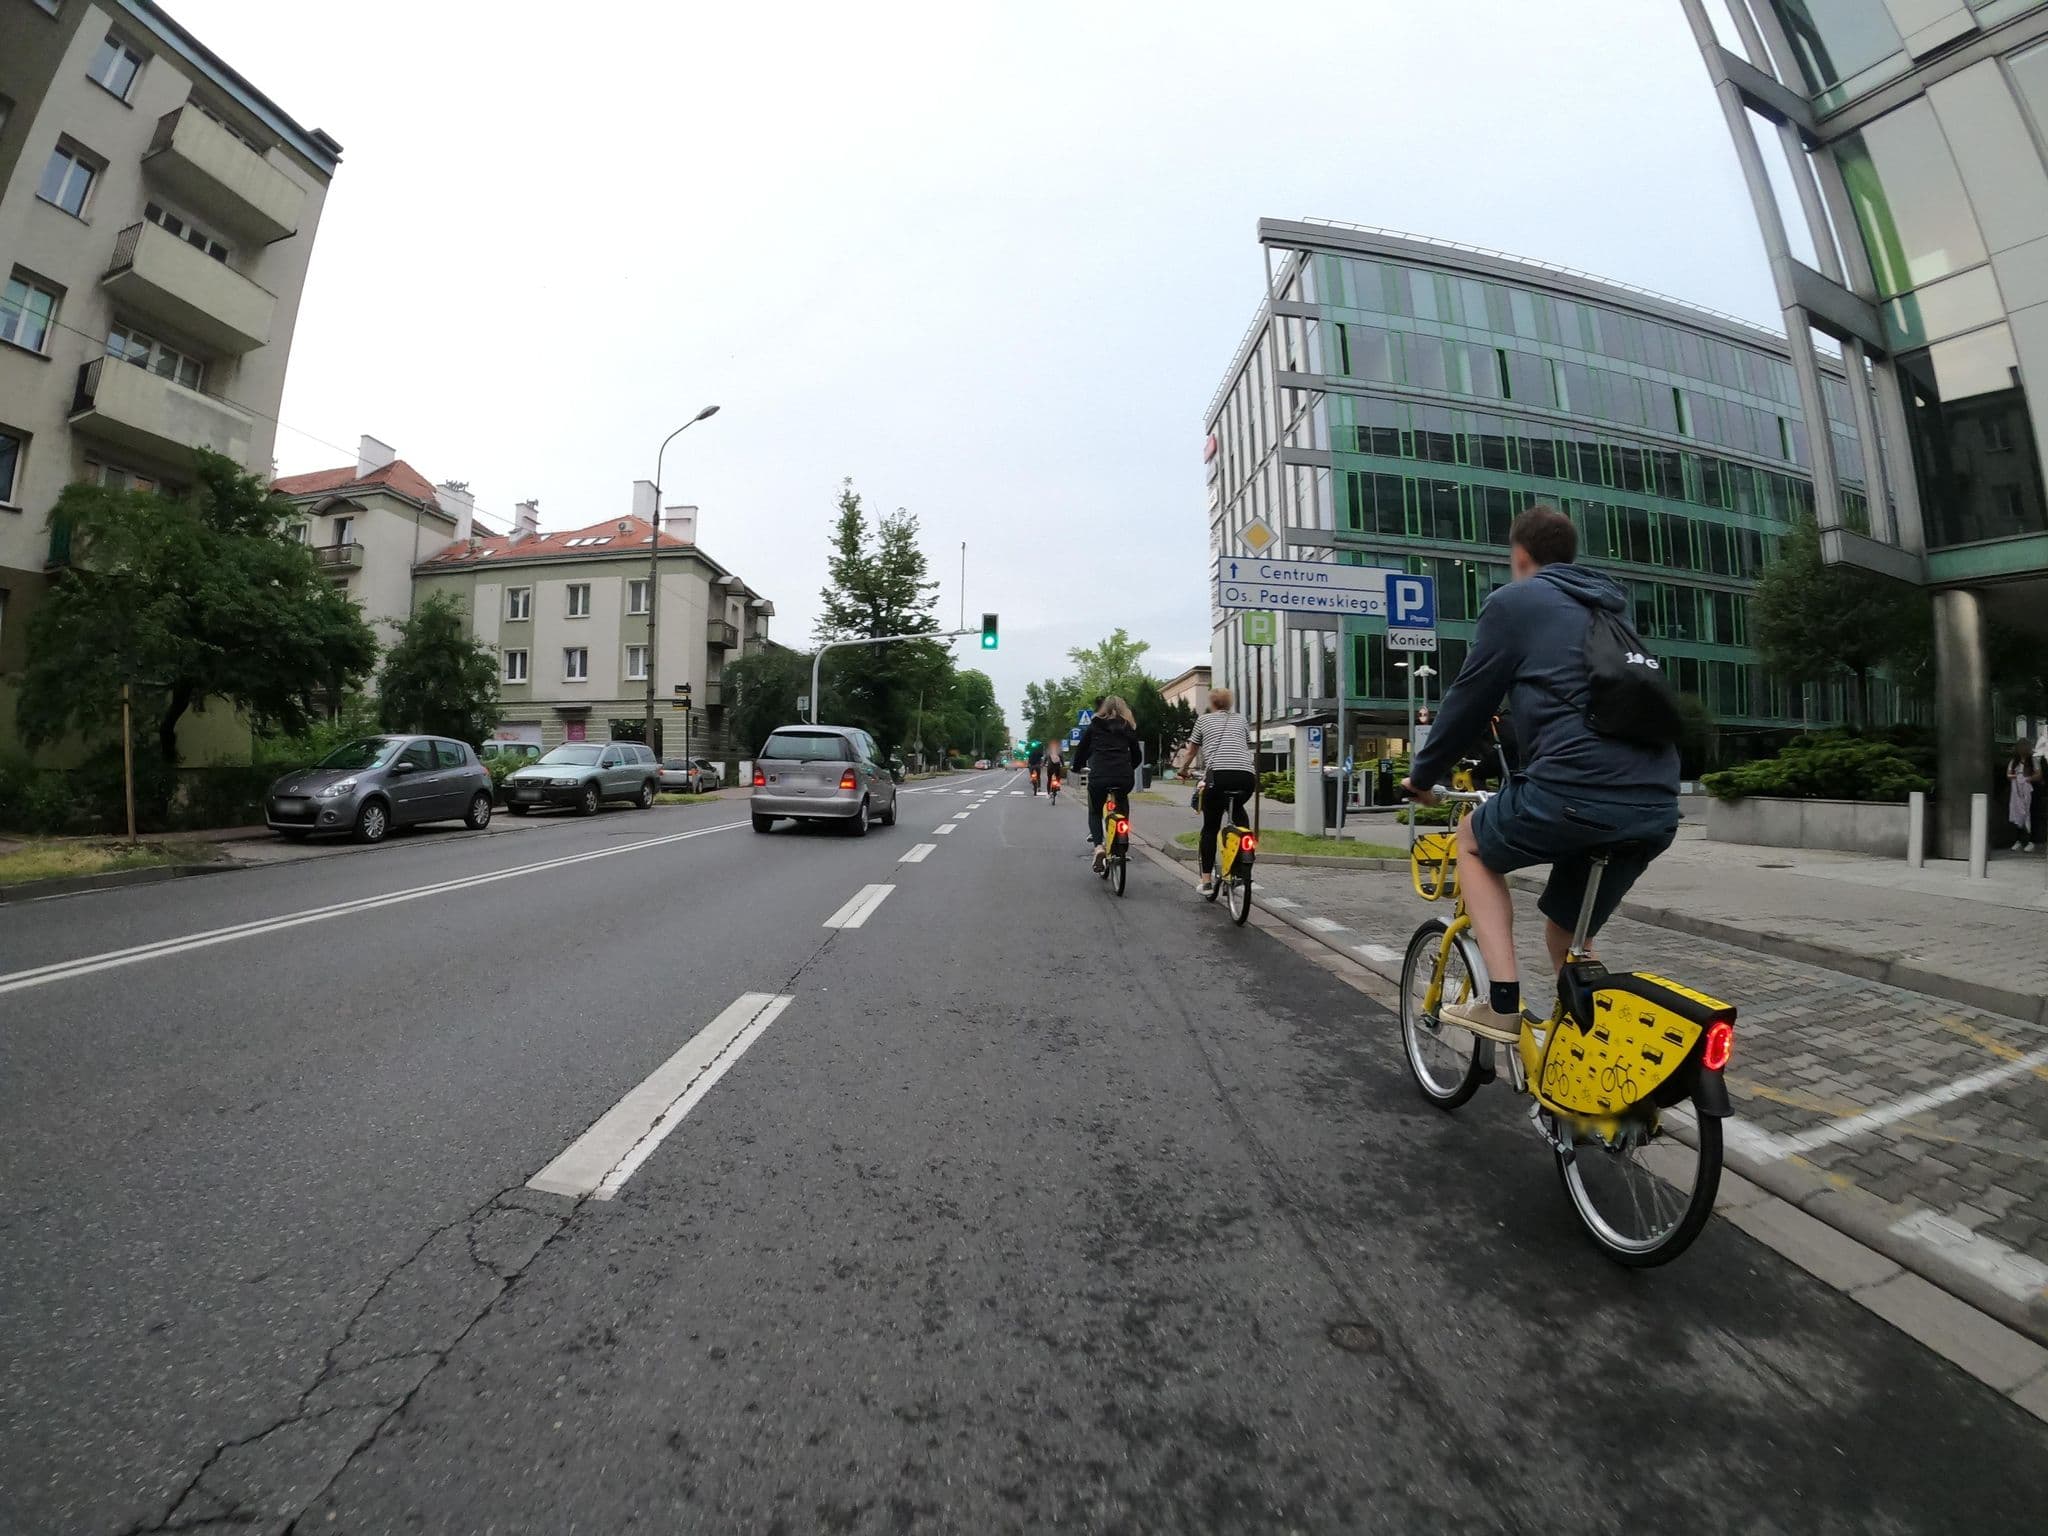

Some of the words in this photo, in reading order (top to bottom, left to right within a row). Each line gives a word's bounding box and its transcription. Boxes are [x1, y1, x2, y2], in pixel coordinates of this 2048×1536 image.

[1259, 565, 1328, 582] Centrum
[1225, 587, 1252, 602] Os.
[1260, 589, 1378, 612] Paderewskiego
[1396, 580, 1424, 621] P
[1251, 616, 1268, 640] P
[1390, 632, 1434, 647] Koniec
[1072, 731, 1079, 739] P
[1309, 728, 1320, 741] P
